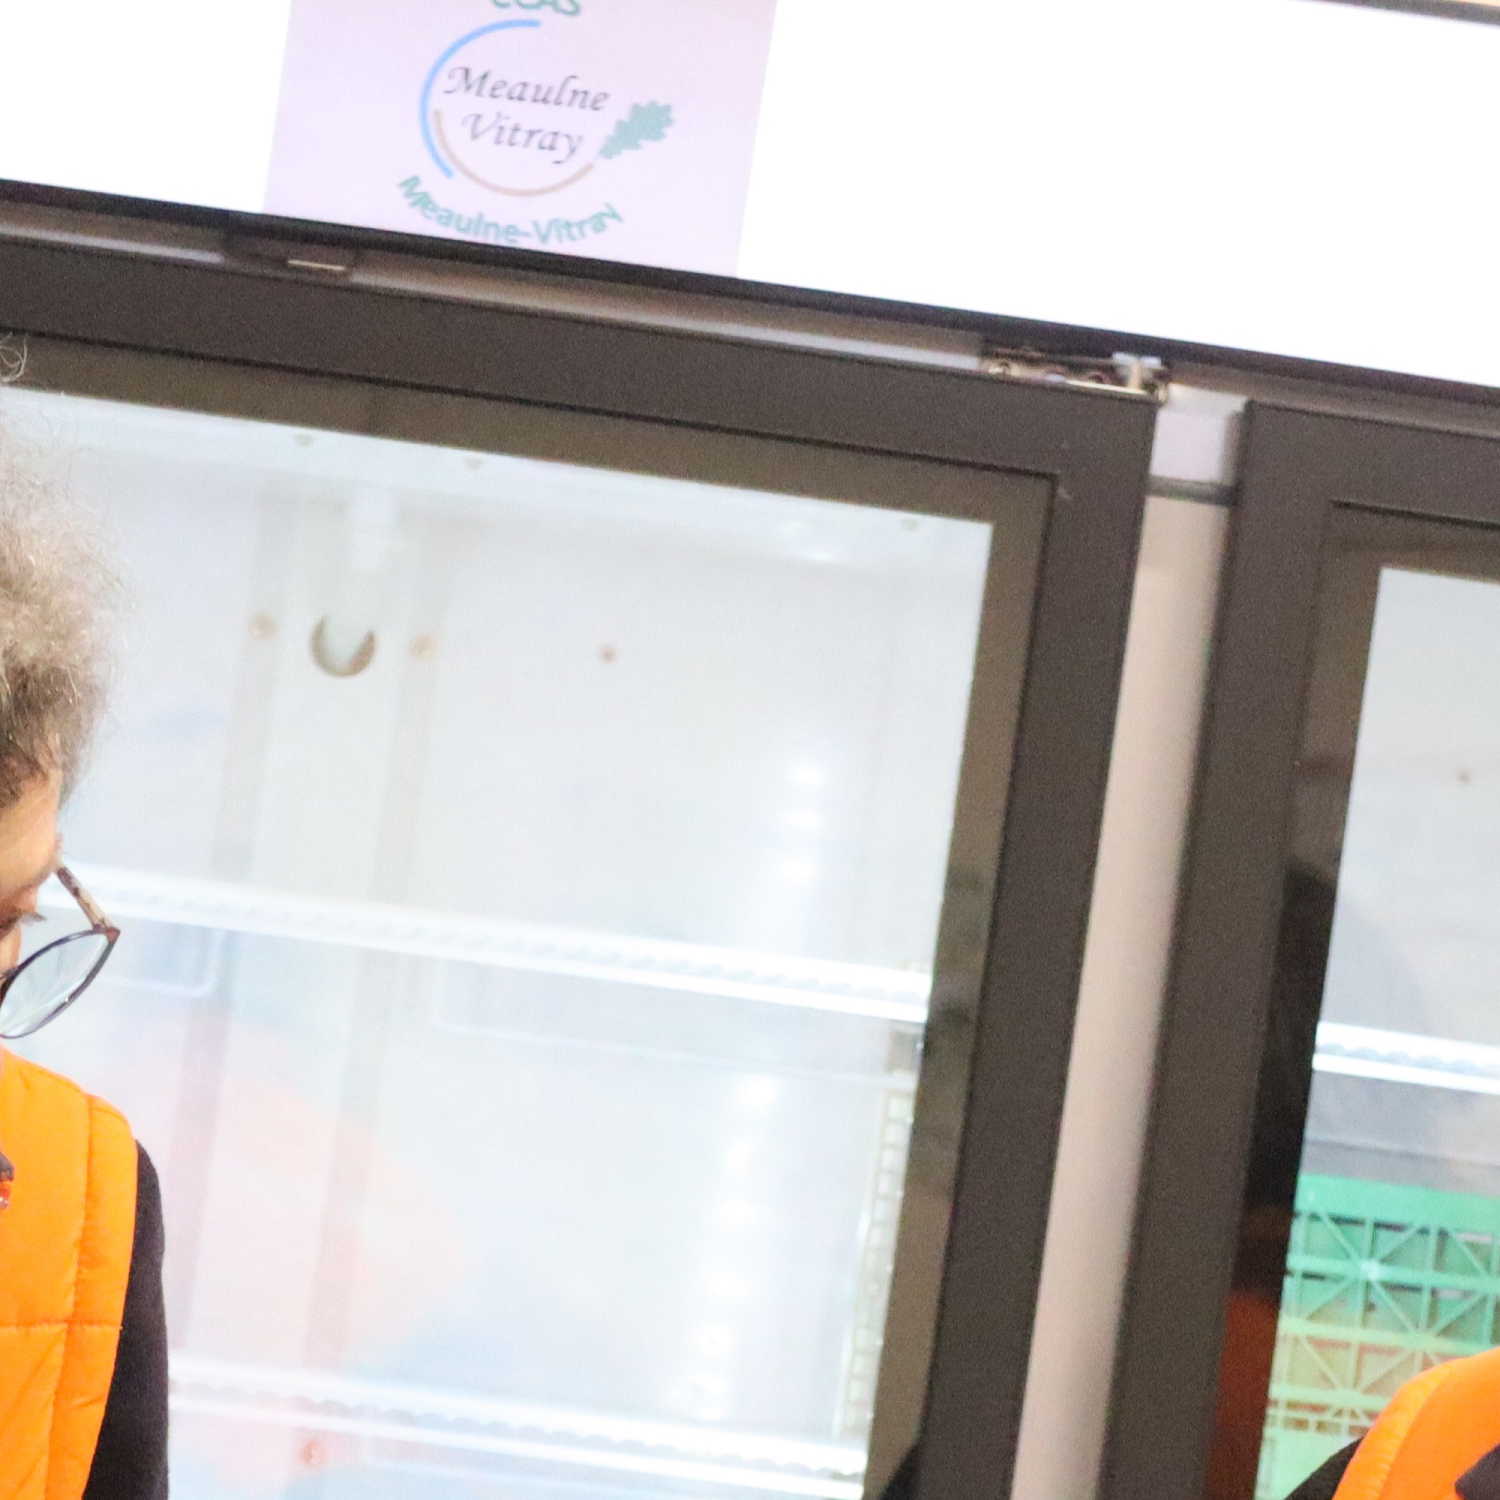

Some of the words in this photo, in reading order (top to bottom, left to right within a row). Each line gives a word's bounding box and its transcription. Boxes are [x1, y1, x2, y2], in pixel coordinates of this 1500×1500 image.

[443, 65, 610, 112] Meaulne
[461, 111, 584, 164] Vitray
[398, 175, 625, 244] Meaulne-Vitray
